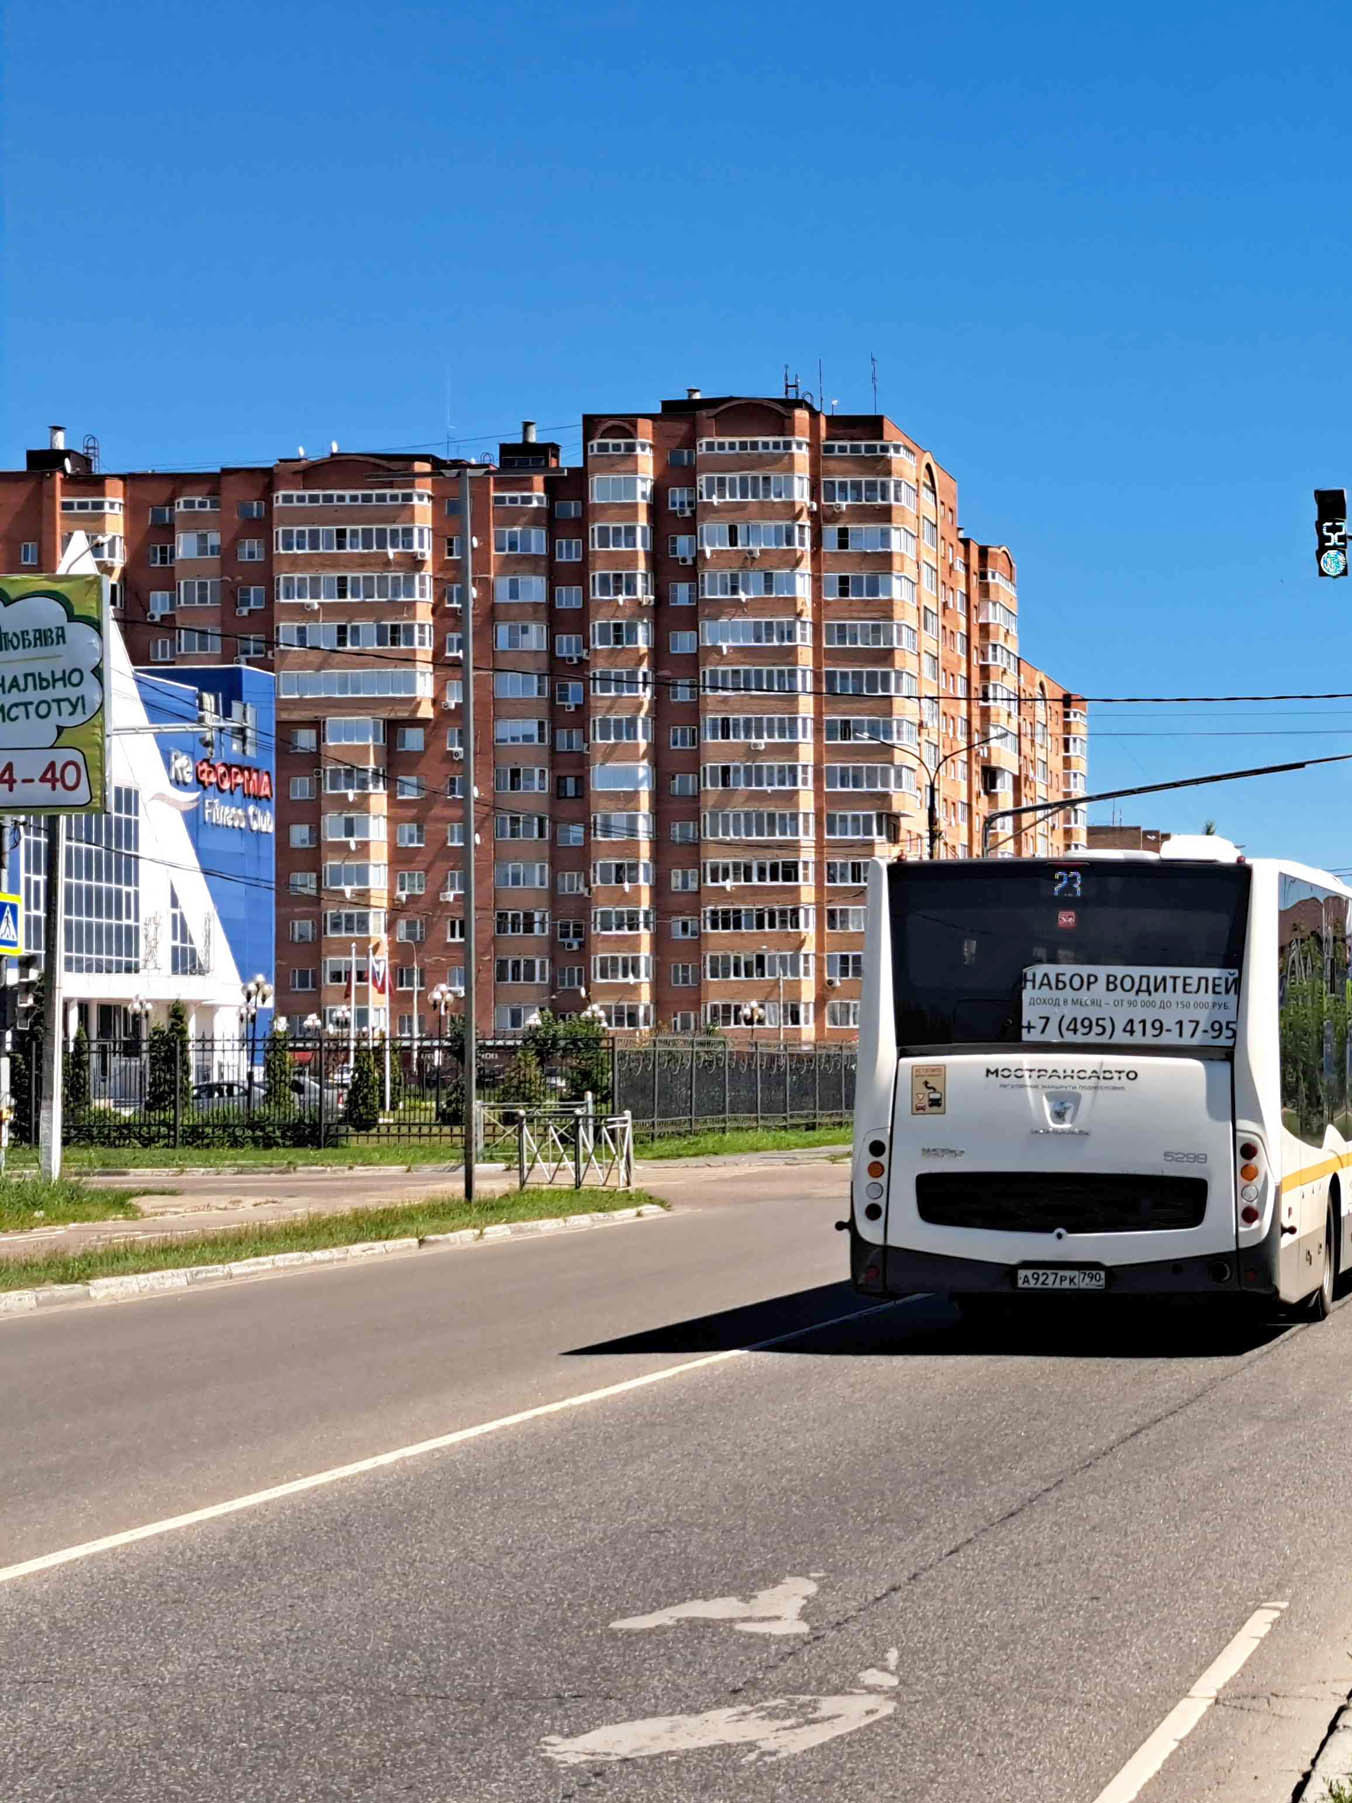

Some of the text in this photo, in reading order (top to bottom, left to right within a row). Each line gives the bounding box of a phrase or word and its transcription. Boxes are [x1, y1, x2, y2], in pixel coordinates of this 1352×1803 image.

[196, 758, 273, 801] ФОРМА
[1023, 971, 1238, 996] НАБОР ВОДИТЕЛЕЙ
[1029, 997, 1061, 1007] ДОХОД
[1071, 998, 1102, 1008] МЕСЯЦ
[1113, 999, 1124, 1008] ОТ
[1127, 999, 1138, 1008] 90
[1140, 999, 1156, 1008] 000
[1159, 1000, 1172, 1010] ДО
[1176, 1000, 1191, 1009] 150
[1193, 1001, 1209, 1010] 000
[1022, 1014, 1237, 1039] +7 (495) 419-17-95
[985, 1067, 1138, 1081] МОСТРАНСАВТО
